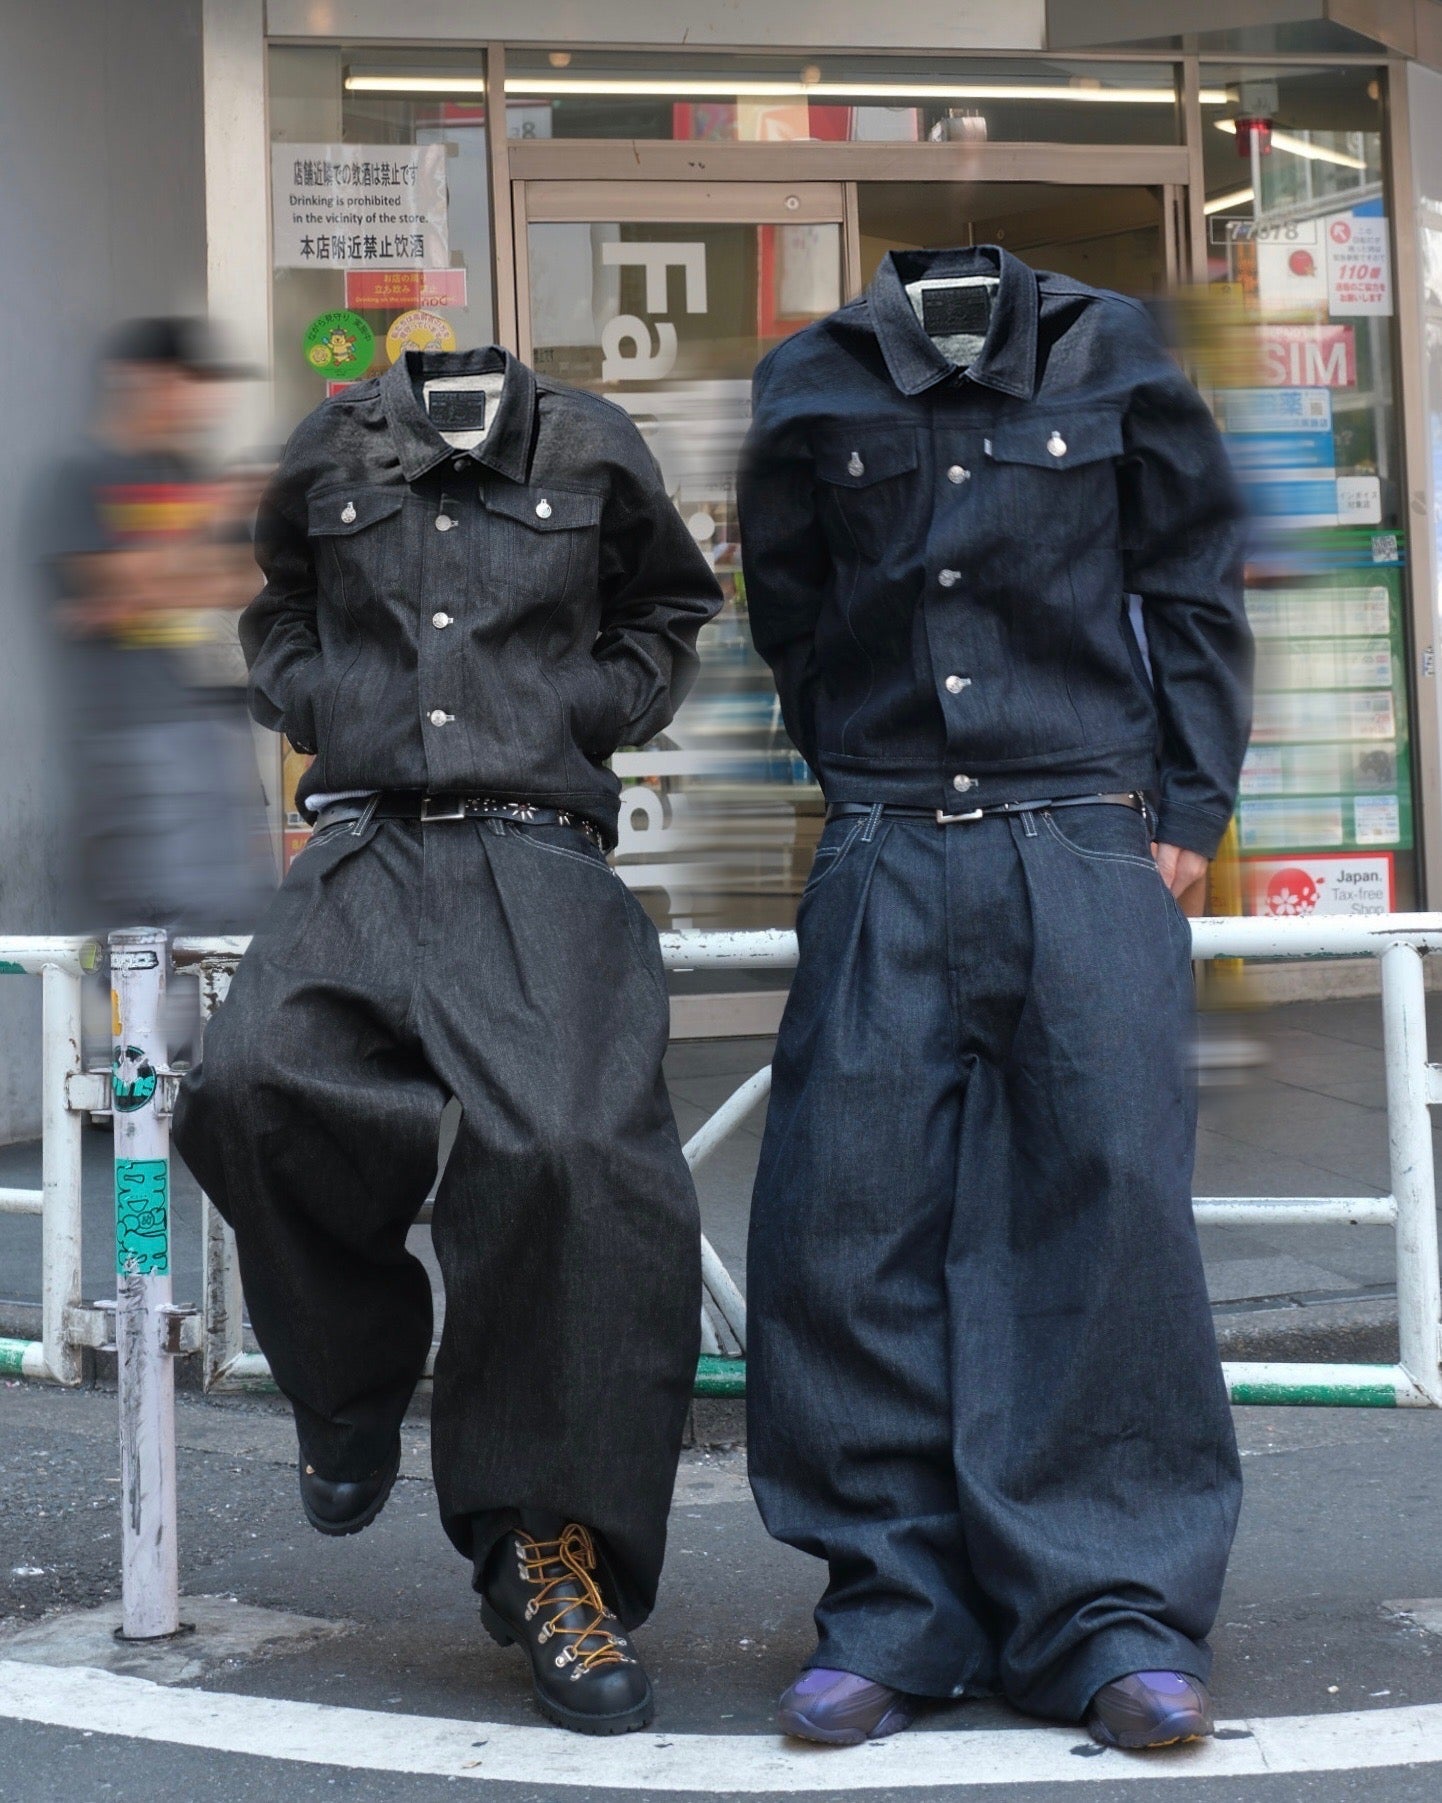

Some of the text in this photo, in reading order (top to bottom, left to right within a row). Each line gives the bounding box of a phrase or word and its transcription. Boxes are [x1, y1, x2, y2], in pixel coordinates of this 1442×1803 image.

[293, 160, 418, 187] 店舗近隣での飲酒は禁止です
[289, 195, 401, 208] Drinking is prohibited
[292, 213, 429, 226] in the vicinity of the store.
[300, 234, 424, 260] 本店附近禁止饮酒
[1263, 343, 1347, 385] SIM
[1337, 870, 1382, 886] Japan.
[1332, 888, 1384, 901] Tax-free
